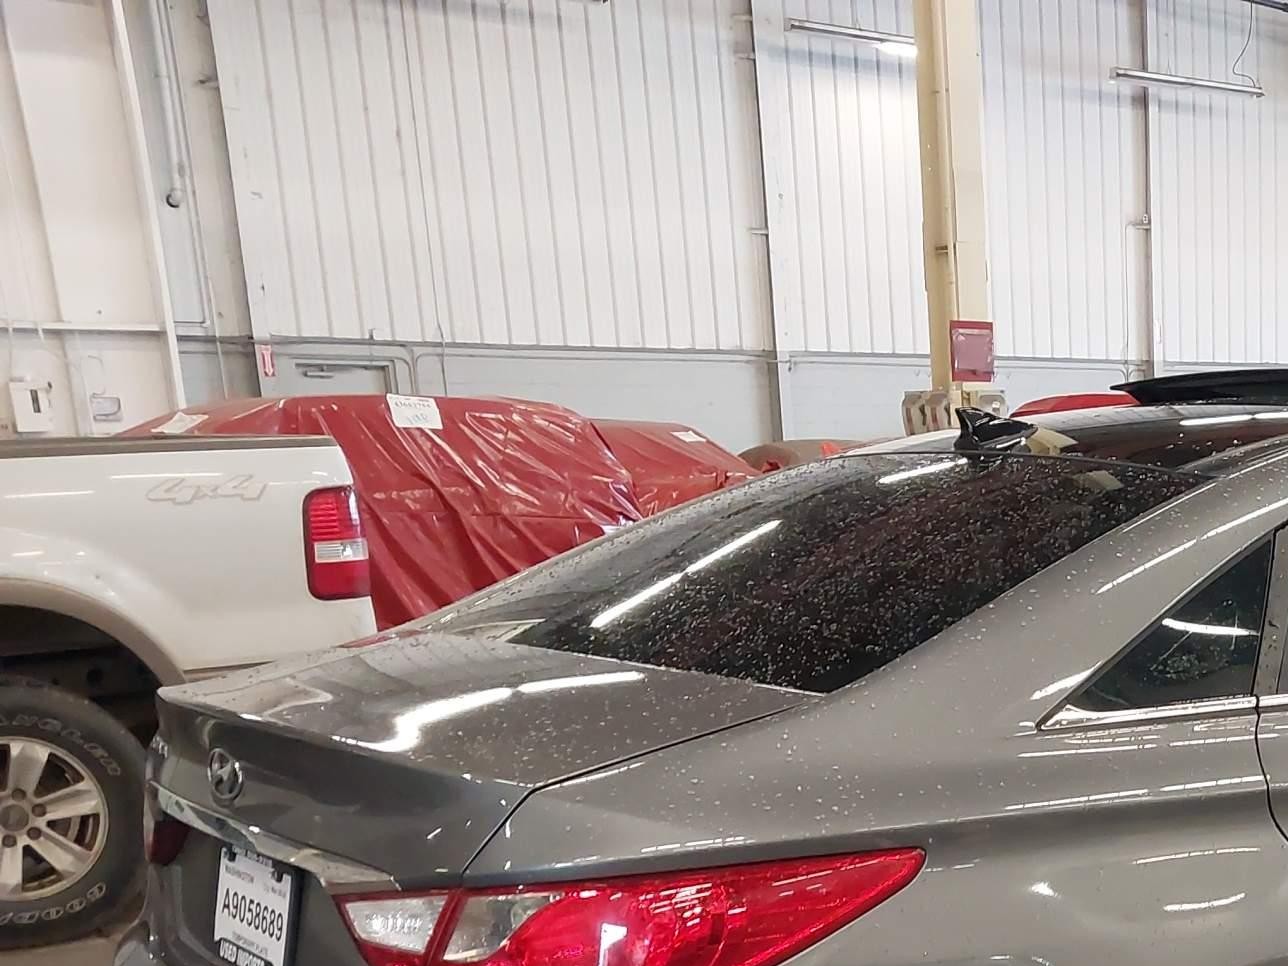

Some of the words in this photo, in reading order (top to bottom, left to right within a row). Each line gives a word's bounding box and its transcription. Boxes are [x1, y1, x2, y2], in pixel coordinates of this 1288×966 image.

[145, 475, 267, 505] 4x4
[222, 887, 284, 941] A9058689
[220, 939, 237, 962] USED
